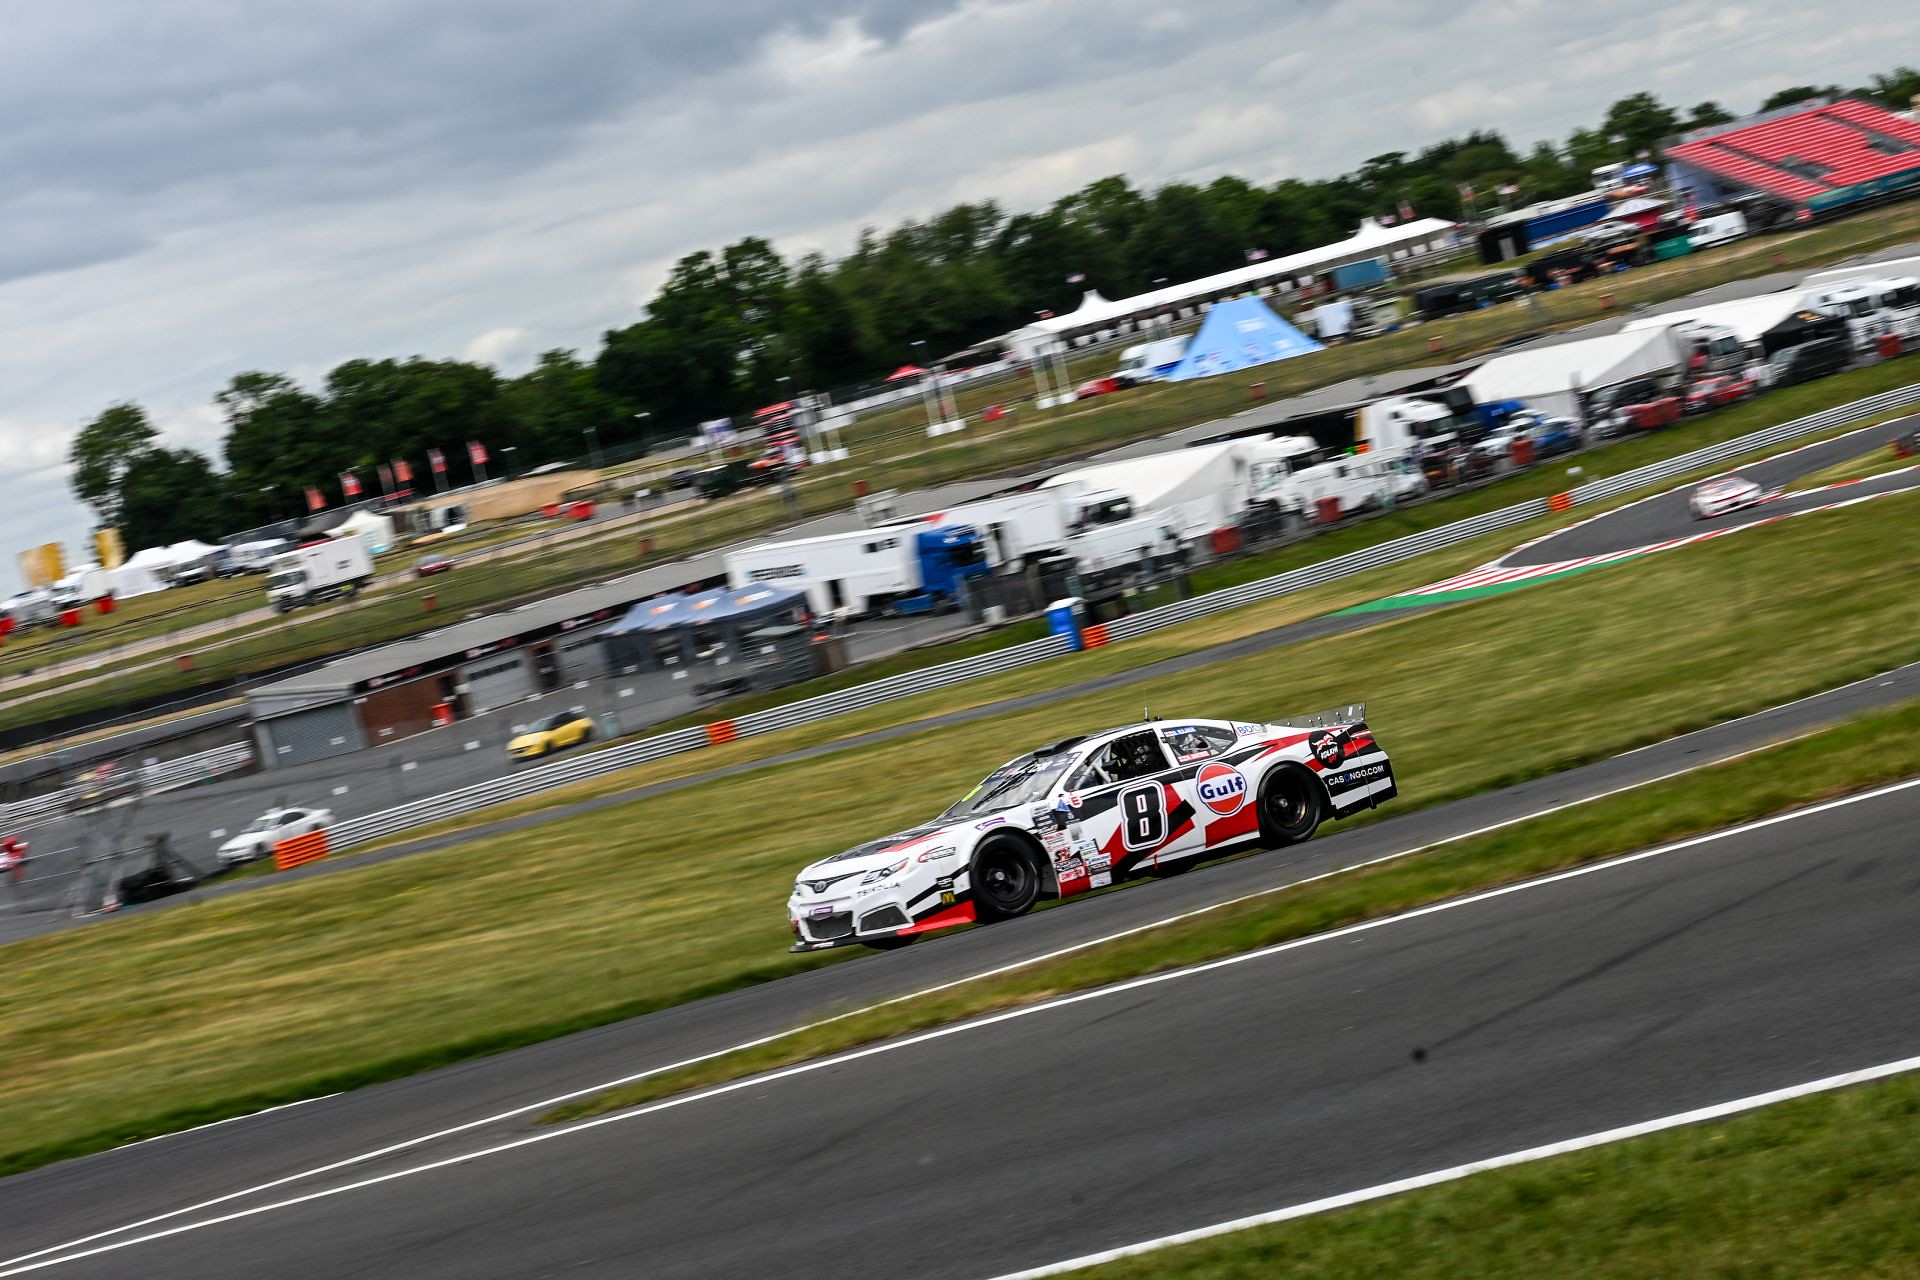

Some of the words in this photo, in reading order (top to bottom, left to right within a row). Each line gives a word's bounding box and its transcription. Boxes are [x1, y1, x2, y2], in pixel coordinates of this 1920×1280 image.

[1237, 724, 1261, 735] BDO
[1200, 776, 1244, 800] Gulf
[1121, 783, 1165, 848] 8
